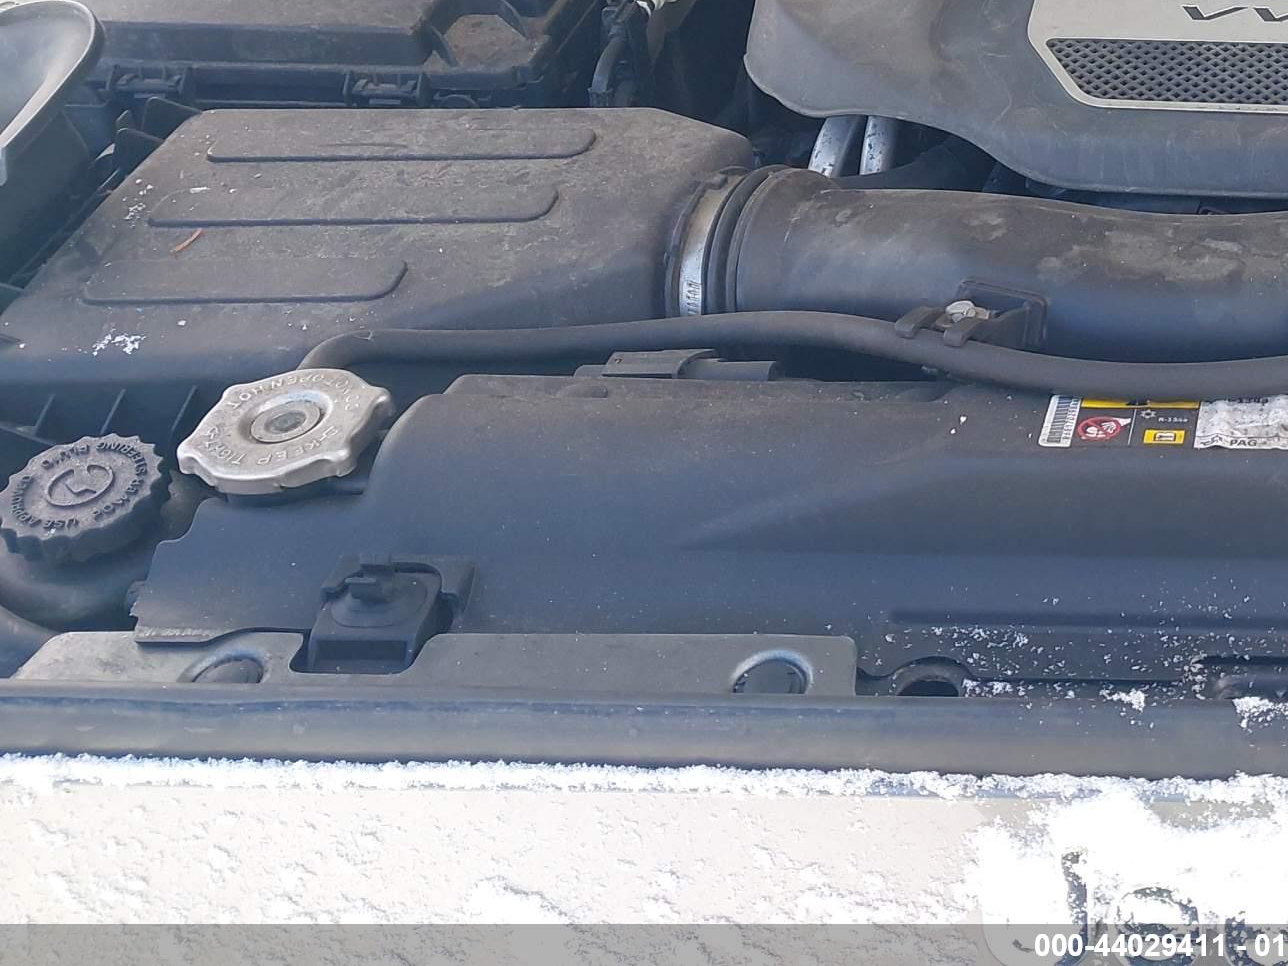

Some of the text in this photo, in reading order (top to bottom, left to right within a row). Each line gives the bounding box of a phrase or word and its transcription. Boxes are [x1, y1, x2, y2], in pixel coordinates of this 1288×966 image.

[271, 373, 326, 389] OPEN
[226, 384, 268, 411] HOT
[256, 440, 321, 467] KEEP
[1230, 439, 1257, 447] PAG
